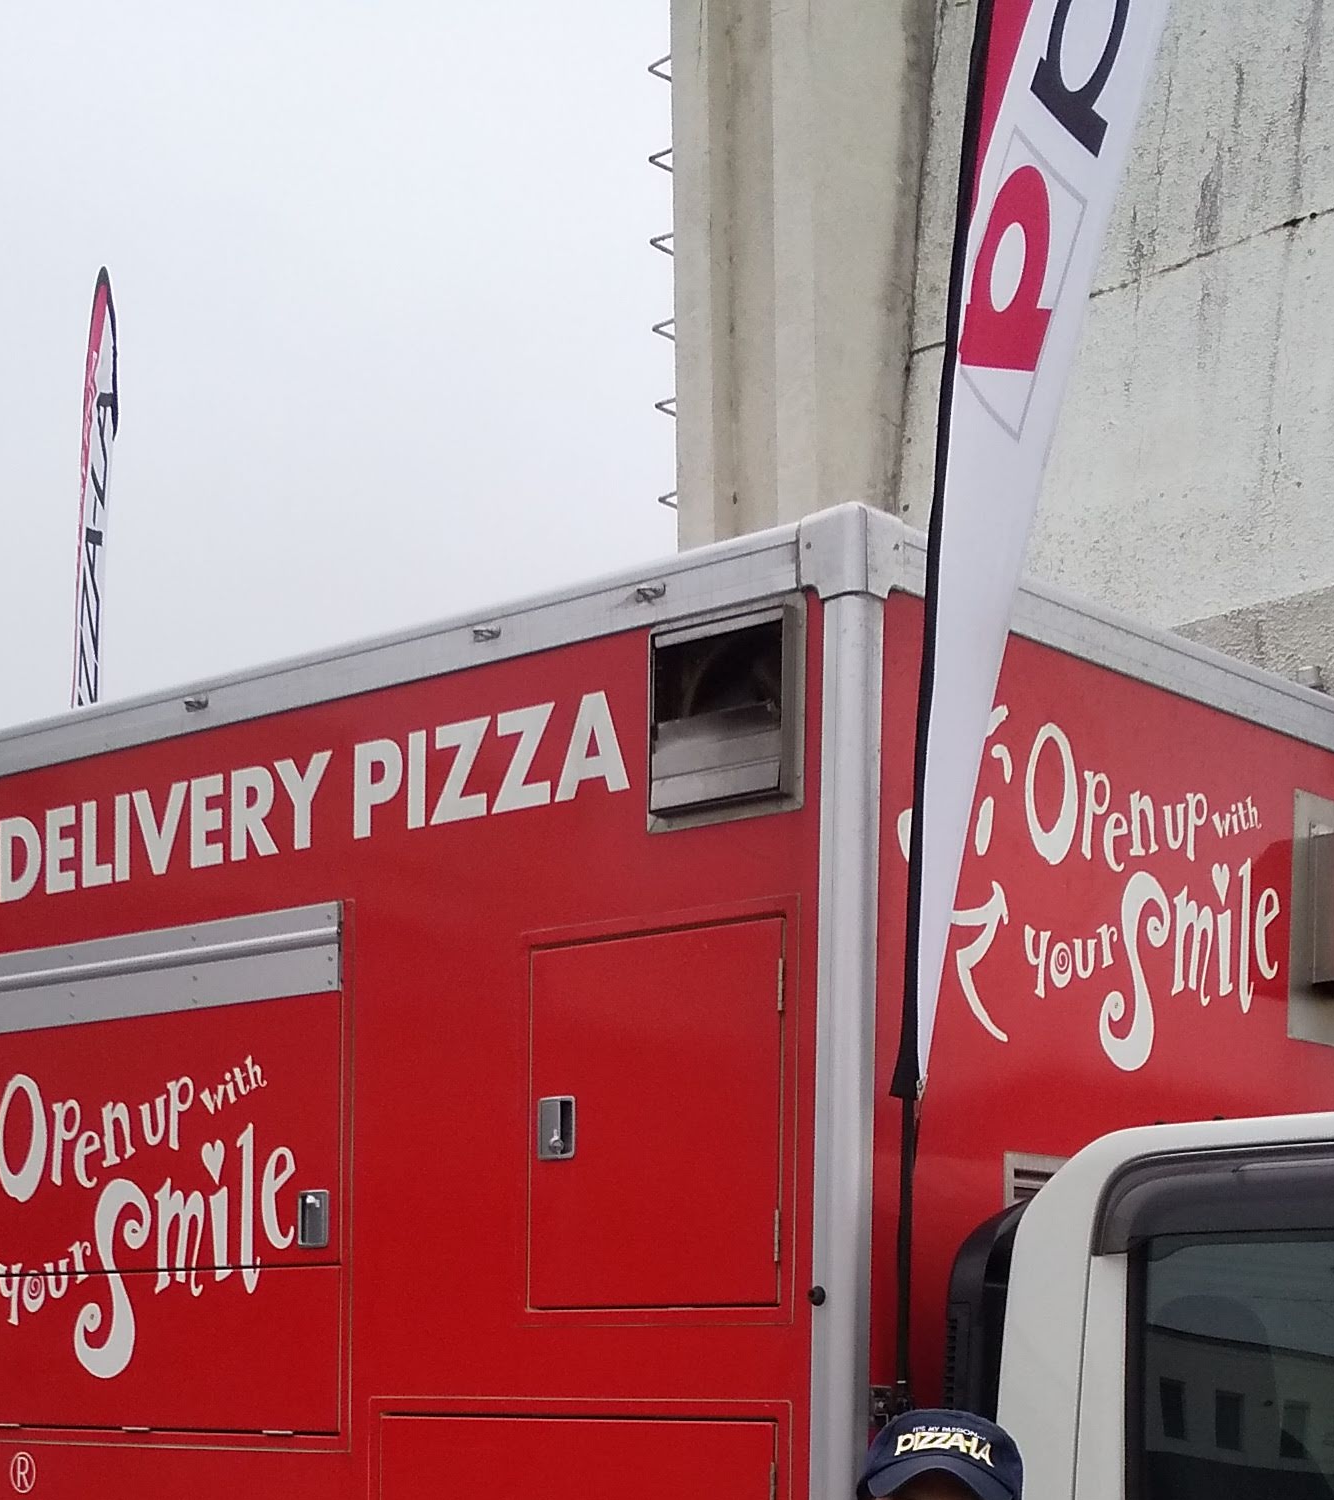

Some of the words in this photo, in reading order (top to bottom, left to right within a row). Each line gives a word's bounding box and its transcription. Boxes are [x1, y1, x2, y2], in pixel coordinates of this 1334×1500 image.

[353, 691, 631, 840] PIZZA
[1025, 722, 1158, 872] Open
[1163, 792, 1208, 861] up
[1211, 796, 1262, 839] with
[1025, 925, 1117, 998] your
[1099, 858, 1280, 1071] Smile
[139, 1074, 194, 1152] up
[200, 1055, 267, 1115] with
[72, 1122, 297, 1379] Smile
